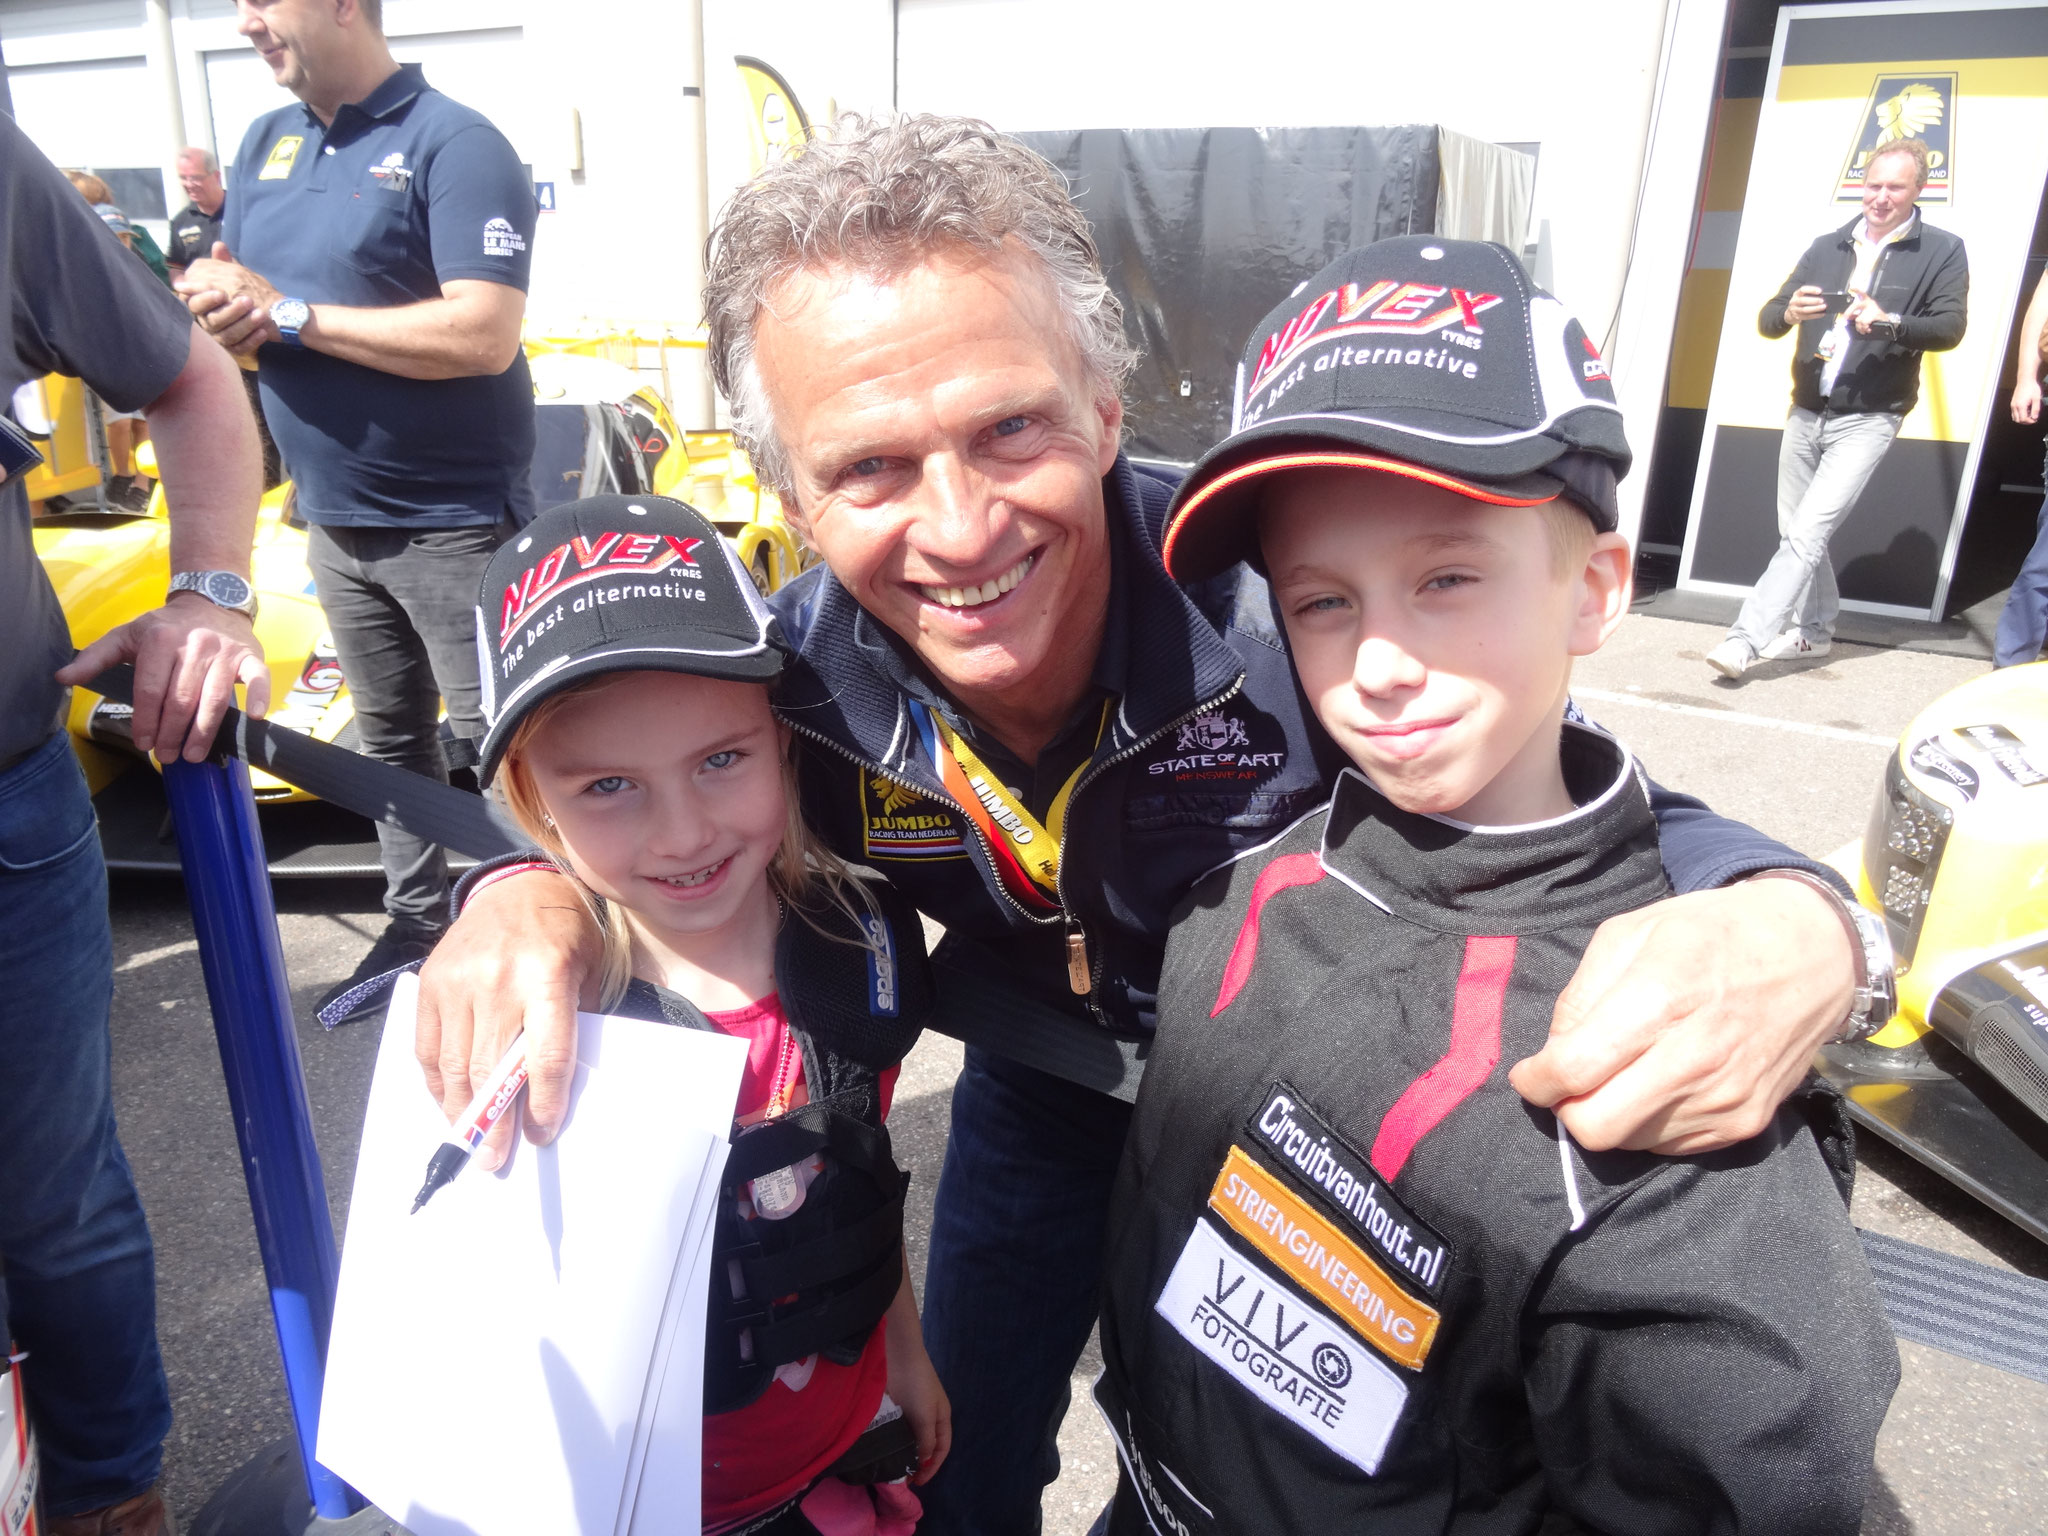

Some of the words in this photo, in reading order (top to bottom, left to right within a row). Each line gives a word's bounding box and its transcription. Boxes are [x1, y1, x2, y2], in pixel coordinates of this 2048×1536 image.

[484, 238, 497, 247] LE
[500, 239, 526, 251] MANS
[484, 247, 513, 256] SERIES
[1249, 280, 1502, 394] NOVEX
[1441, 330, 1482, 350] TYRES
[1267, 361, 1306, 409] best
[1314, 346, 1478, 379] alternative
[500, 532, 704, 637] NOVEX
[670, 568, 703, 580] TYRES
[502, 647, 524, 679] The
[527, 608, 564, 646] best
[573, 583, 706, 613] alternative
[1149, 754, 1216, 774] STATE
[1217, 753, 1236, 762] OF
[1238, 753, 1284, 767] ART
[1176, 770, 1257, 782] MENSWEAR
[871, 814, 951, 830] JUMBO
[869, 831, 896, 839] RACING
[897, 831, 917, 839] TEAM
[918, 829, 957, 838] NEDERLAN
[1259, 1095, 1445, 1288] Circuitvanhout.nl
[1223, 1173, 1416, 1344] STRIENGINEERING
[1190, 1303, 1346, 1430] FOTOGRAFIE
